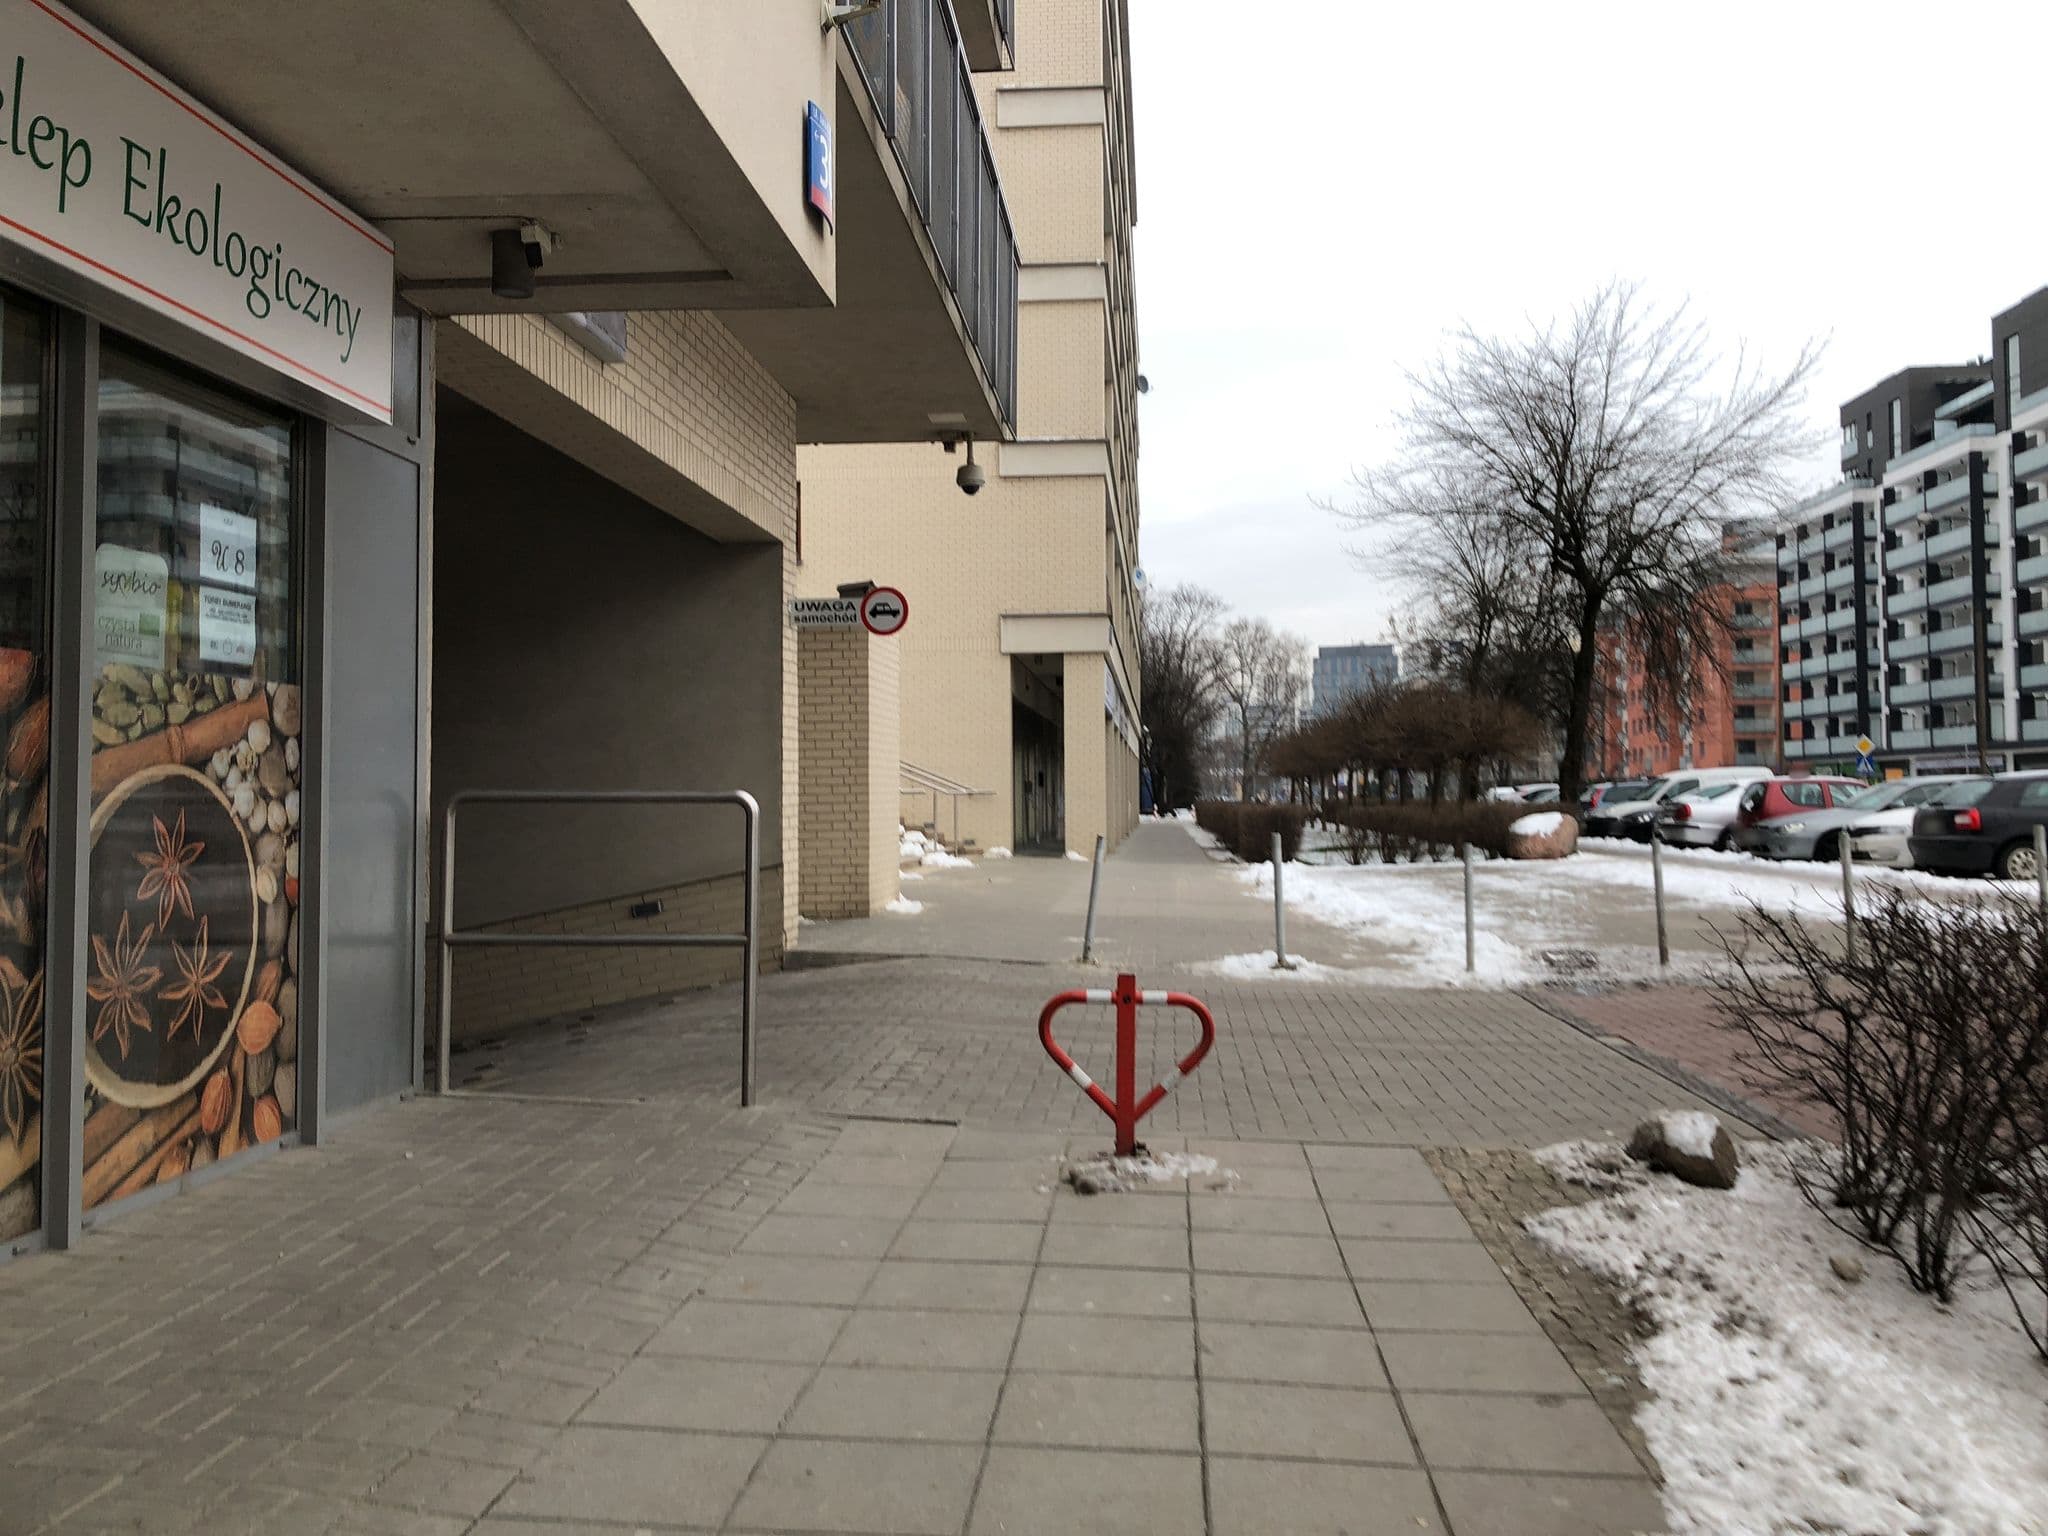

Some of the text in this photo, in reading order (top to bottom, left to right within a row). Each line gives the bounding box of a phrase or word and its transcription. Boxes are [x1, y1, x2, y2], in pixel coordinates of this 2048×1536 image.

[0, 55, 362, 364] lep Ekologiczny
[234, 549, 245, 576] 8
[794, 601, 857, 612] UWAGA
[794, 613, 858, 624] samochód
[105, 633, 143, 649] natura
